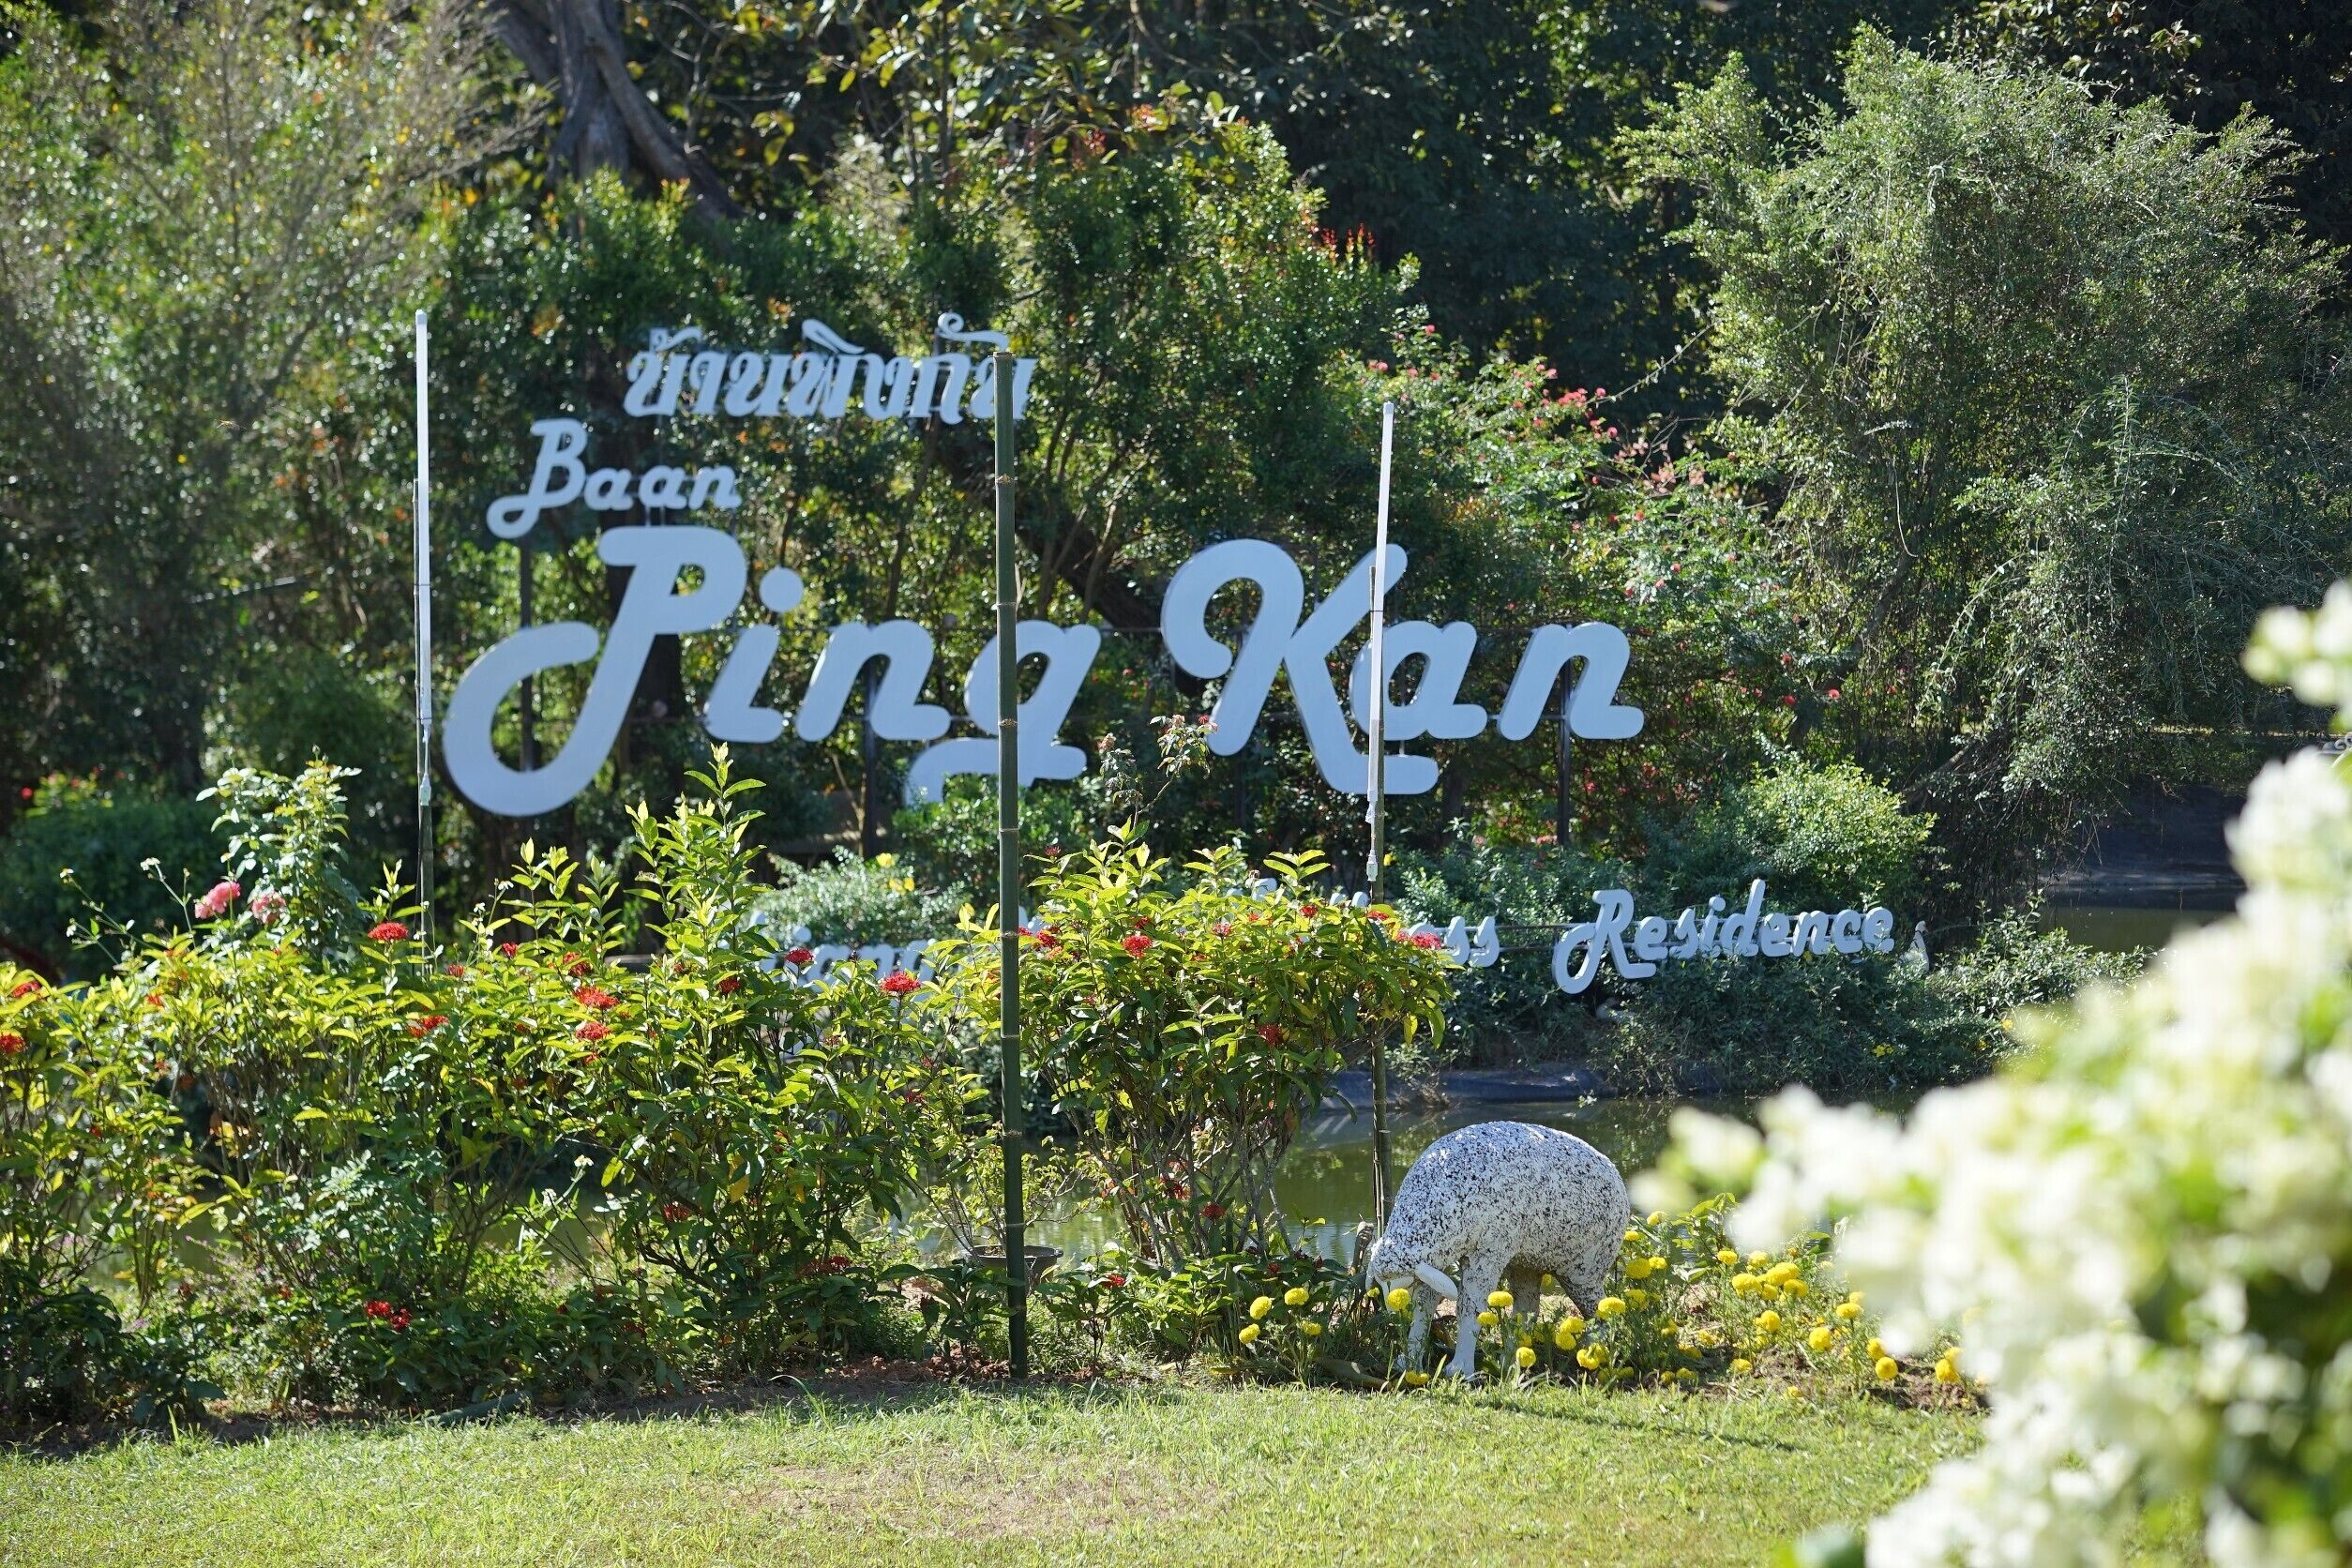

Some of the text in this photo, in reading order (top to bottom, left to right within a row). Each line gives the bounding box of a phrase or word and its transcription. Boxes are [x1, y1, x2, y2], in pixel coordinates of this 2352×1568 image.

[487, 418, 743, 538] Baan
[442, 525, 1645, 816] Ping Kan
[1552, 879, 1894, 994] Residence
